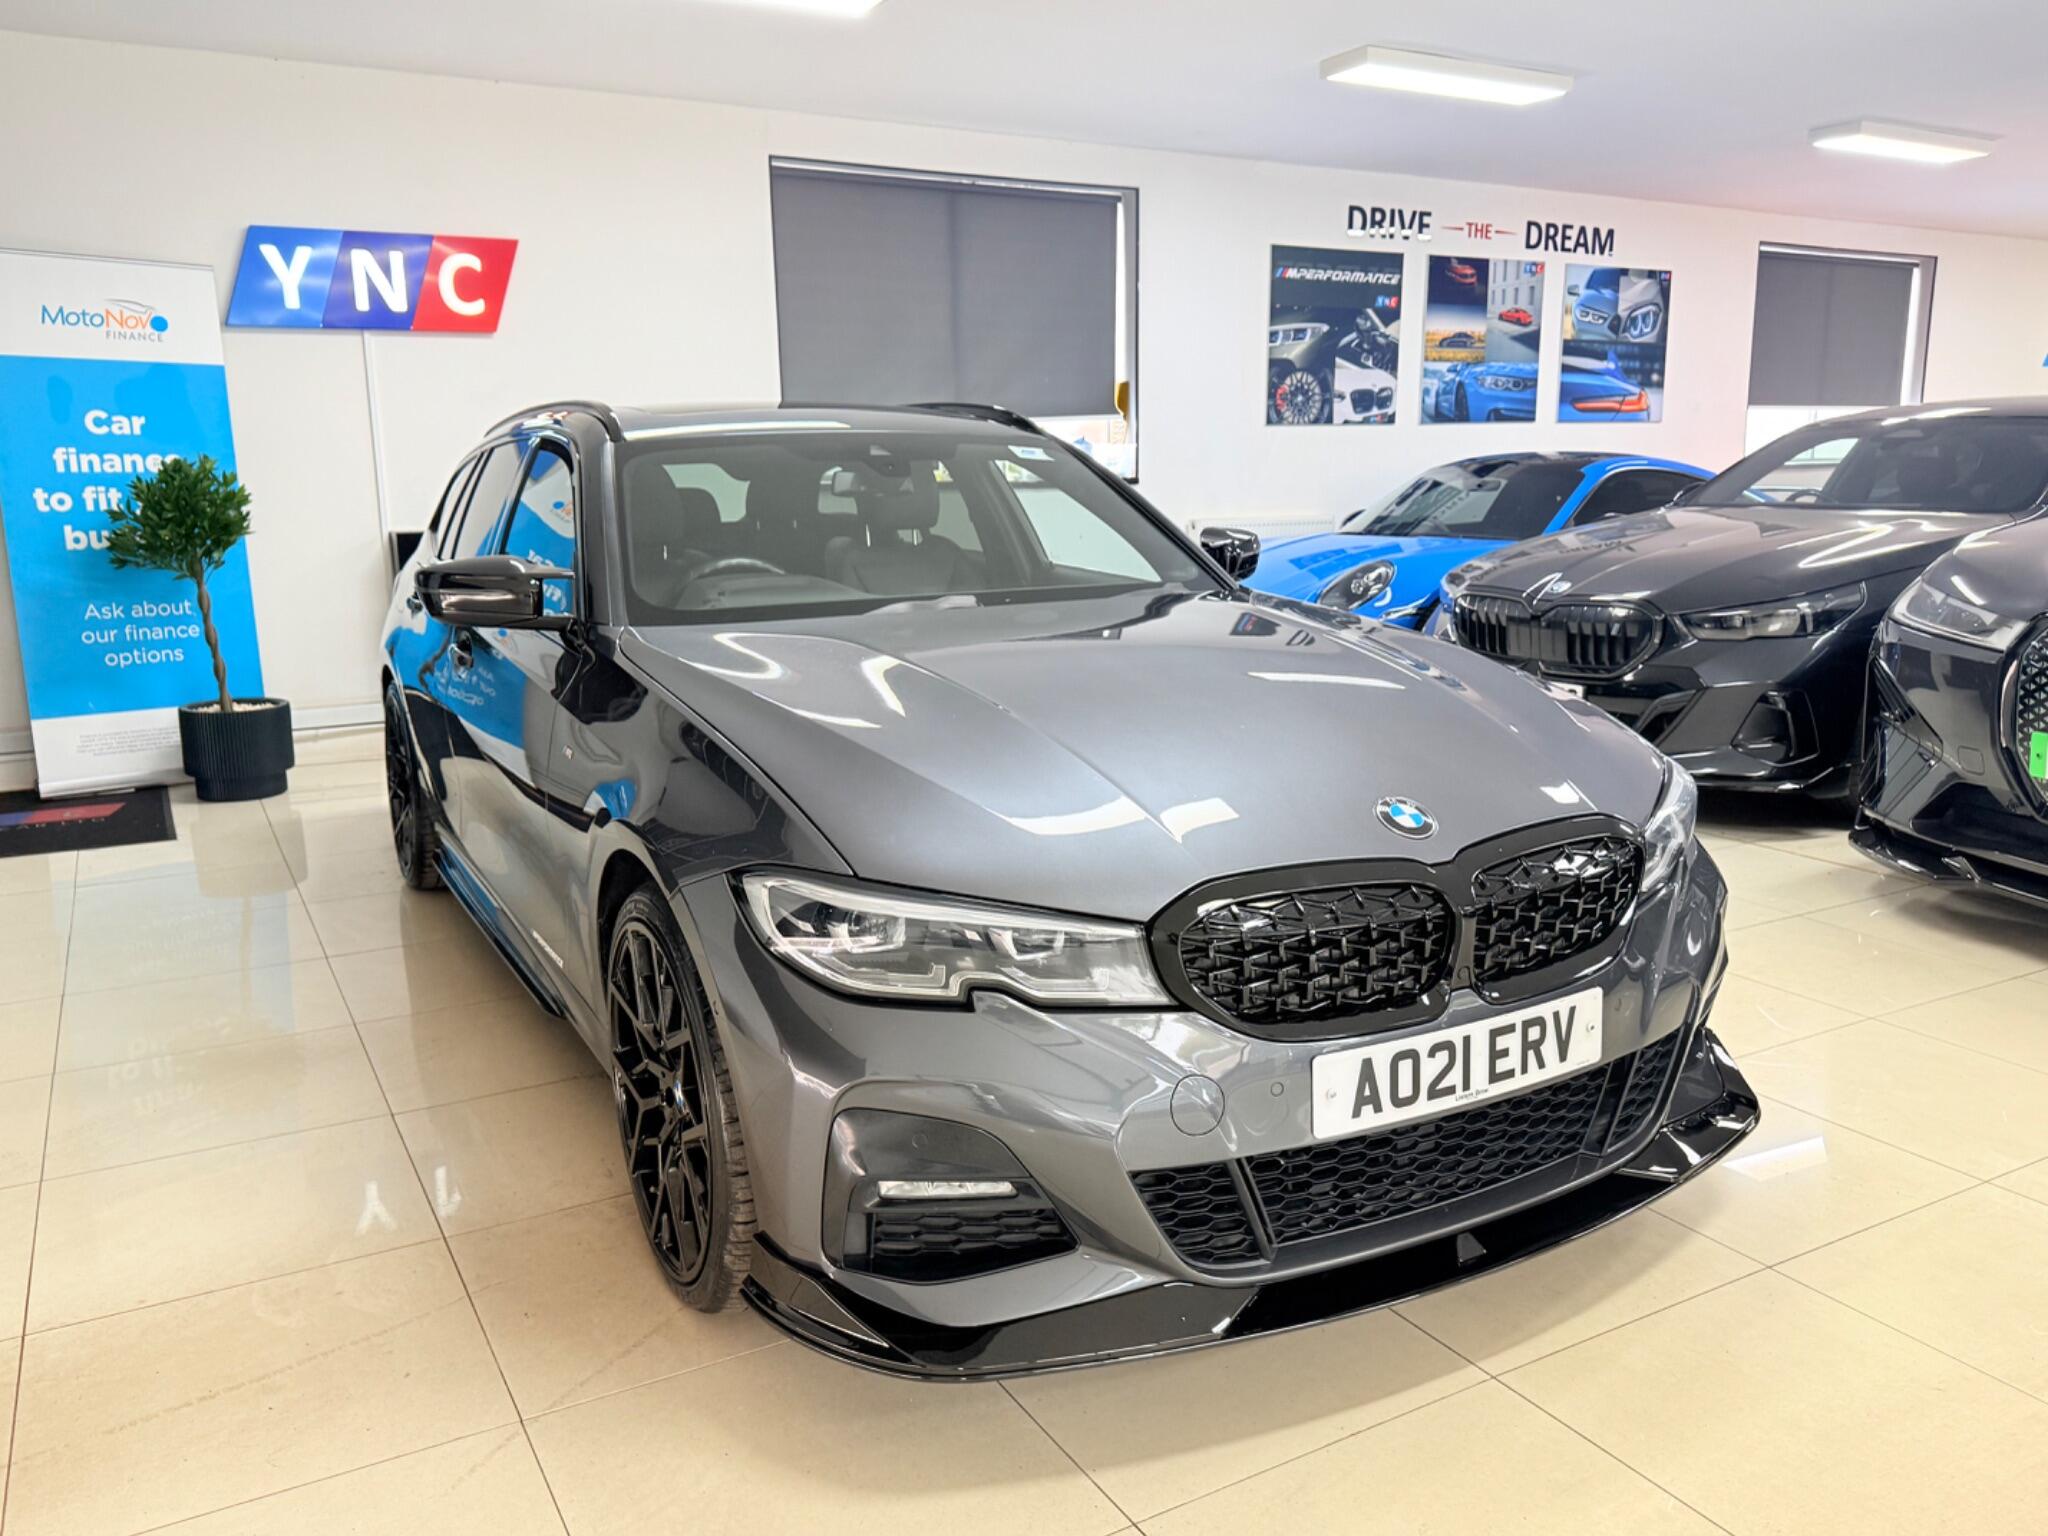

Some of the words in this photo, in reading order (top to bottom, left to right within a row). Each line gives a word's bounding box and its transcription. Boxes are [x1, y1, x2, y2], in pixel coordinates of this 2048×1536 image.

[1346, 205, 1432, 241] DRIVE
[1466, 222, 1492, 239] THE
[1525, 220, 1615, 256] DREAM
[258, 244, 486, 316] YNC
[105, 330, 164, 342] FINANCE
[84, 409, 146, 436] Car
[33, 487, 73, 513] to
[82, 485, 123, 512] fit
[84, 602, 125, 620] Ask
[131, 599, 193, 618] about
[81, 629, 118, 644] our
[124, 623, 200, 642] finance
[104, 647, 185, 669] options
[1351, 1034, 1471, 1119] AO21
[1488, 1005, 1577, 1085] ERV
